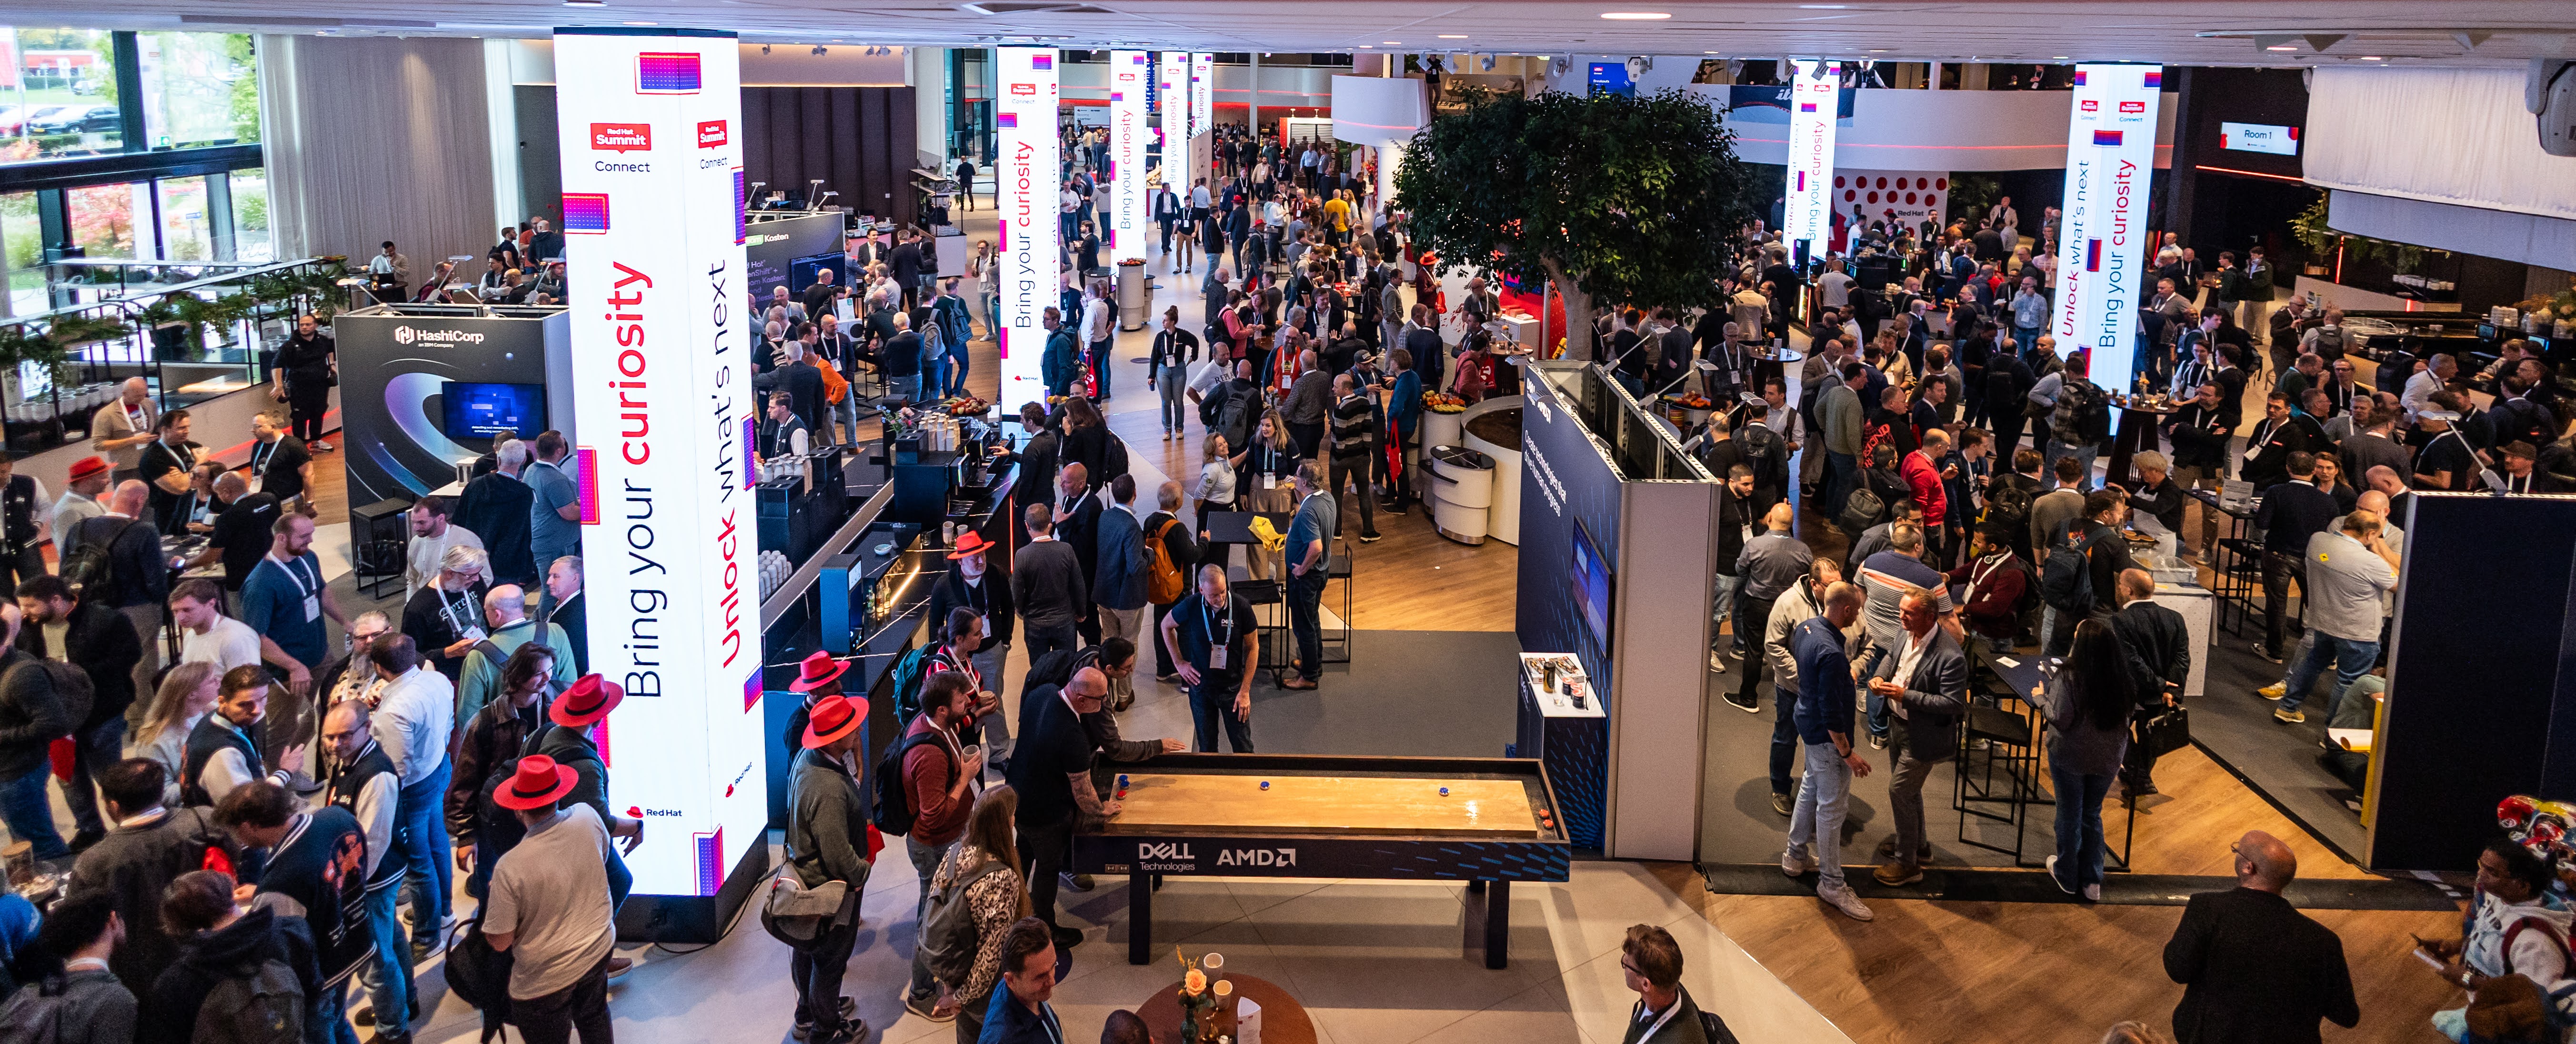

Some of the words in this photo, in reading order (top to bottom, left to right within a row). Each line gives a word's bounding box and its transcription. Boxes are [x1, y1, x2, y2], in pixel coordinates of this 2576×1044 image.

[1170, 95, 1178, 135] curiosity
[1197, 87, 1205, 118] curiosity
[596, 134, 647, 145] Summit
[700, 130, 725, 143] Summit
[1120, 110, 1133, 164] curiosity
[1811, 121, 1826, 176] curiosity
[2244, 130, 2267, 139] Room
[2268, 131, 2272, 140] 1
[595, 161, 651, 172] Connect
[700, 157, 728, 169] Connect
[1013, 141, 1034, 227] curiosity
[1123, 168, 1133, 194] your
[2077, 160, 2089, 201] next
[1120, 199, 1133, 229] Bring
[1810, 180, 1821, 206] your
[2111, 159, 2136, 246] curiosity
[764, 233, 789, 242] Kasten
[1805, 209, 1821, 241] Bring
[2070, 206, 2085, 265] what's
[1019, 232, 1035, 275] your
[2108, 251, 2125, 294] your
[708, 260, 728, 355] next
[1015, 280, 1035, 328] Bring
[2062, 270, 2079, 336] Unlock
[2098, 299, 2124, 347] Bring
[417, 330, 485, 345] HashiCorp
[605, 261, 653, 465] curiosity
[1214, 372, 1236, 384] REPLA
[712, 365, 734, 504] what's
[1524, 450, 1533, 470] drive
[1532, 460, 1544, 491] human
[1544, 483, 1561, 517] progress
[1525, 430, 1536, 455] Create
[1535, 446, 1558, 491] technologies
[1558, 481, 1566, 504] that
[625, 478, 666, 575] your
[717, 507, 740, 669] Unlock
[625, 589, 668, 698] Bring
[1139, 842, 1195, 860] DELL
[1216, 849, 1274, 865] AMD
[1139, 862, 1195, 872] Technologies
